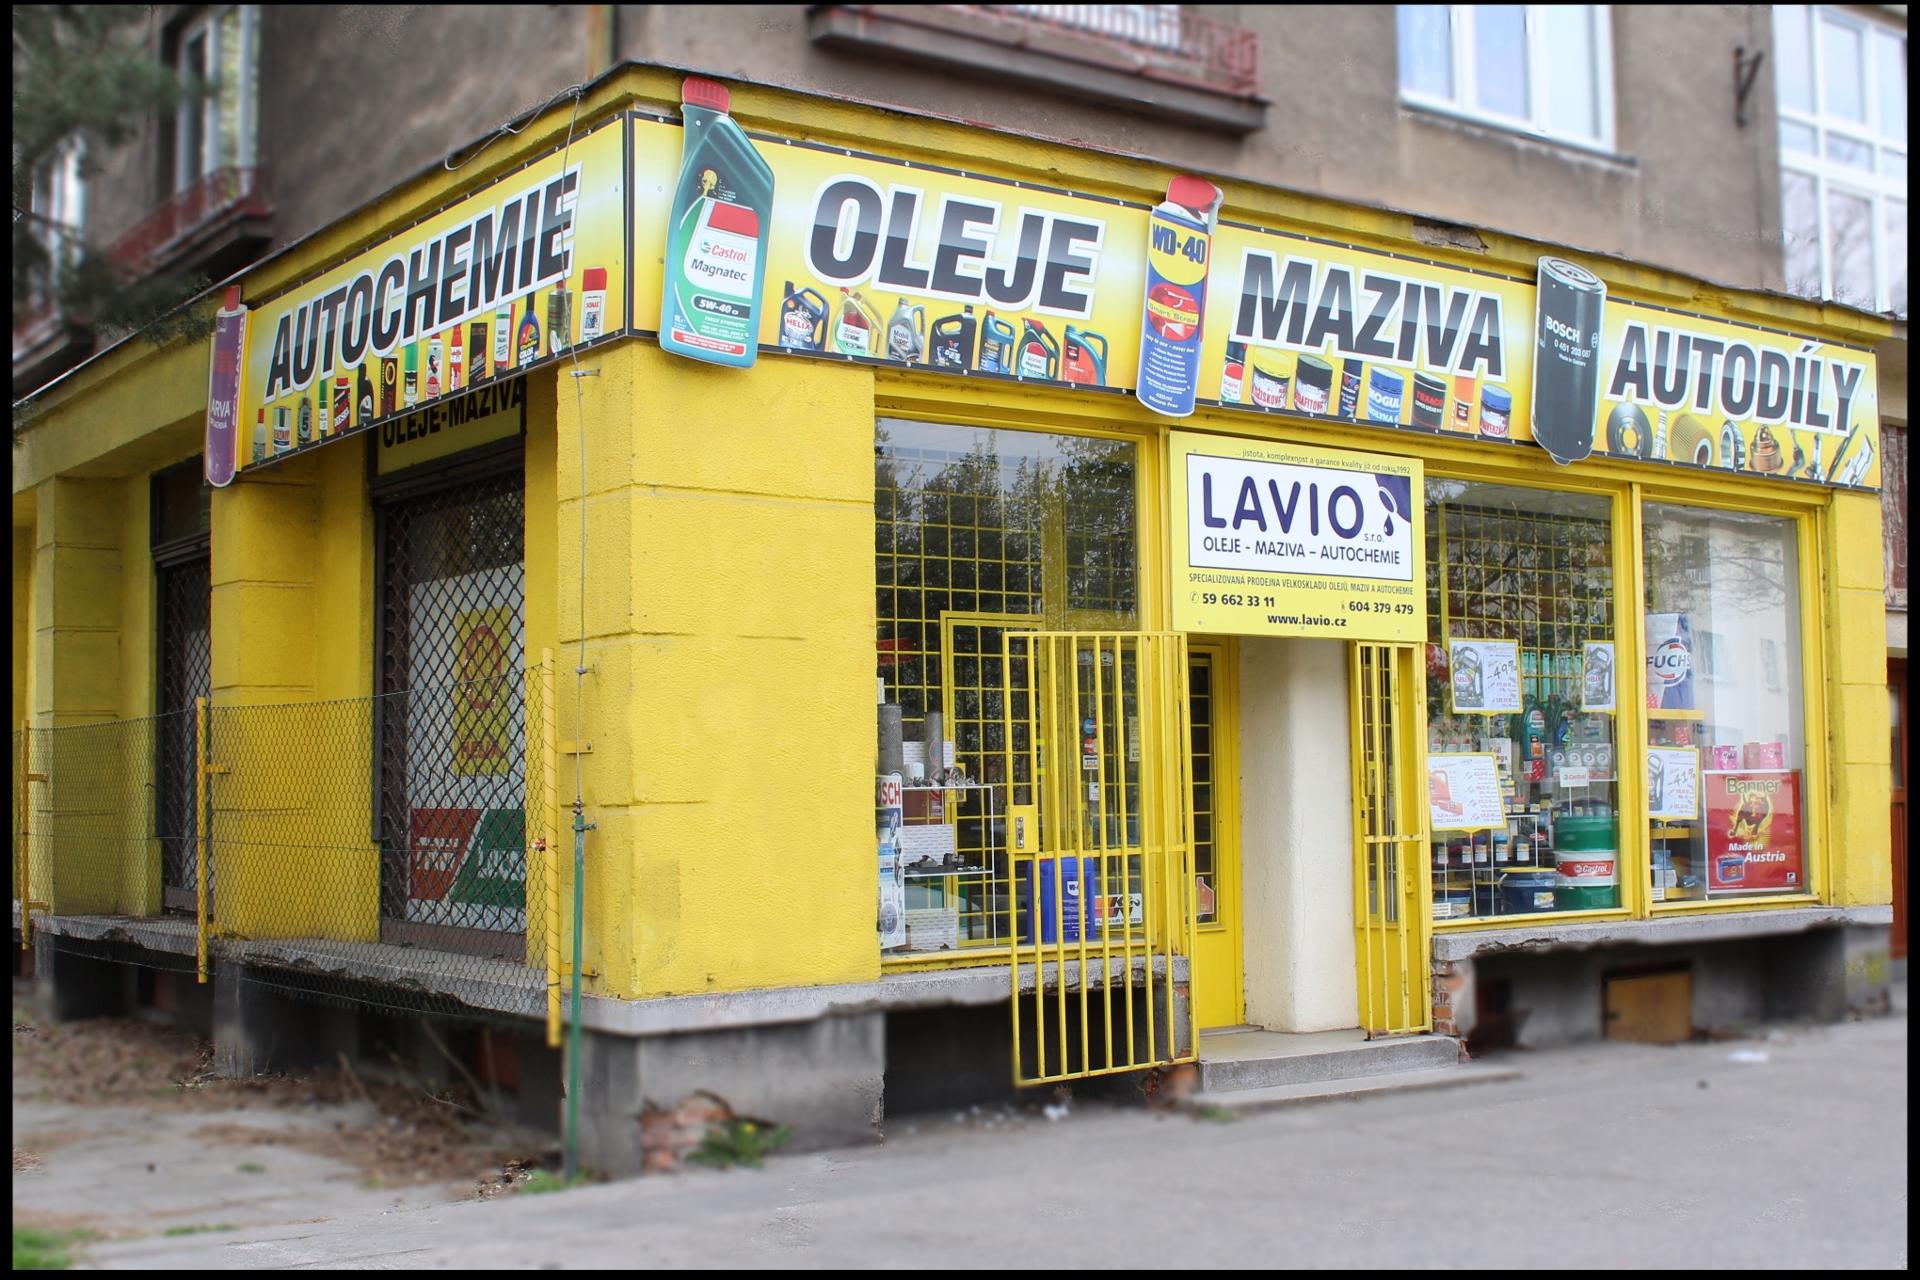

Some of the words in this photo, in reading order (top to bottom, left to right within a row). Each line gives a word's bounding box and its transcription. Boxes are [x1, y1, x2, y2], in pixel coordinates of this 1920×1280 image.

[810, 178, 1100, 315] OLEJE
[1152, 223, 1206, 264] WD-40
[711, 244, 748, 263] Castrol
[690, 258, 748, 281] Magnatec
[265, 167, 581, 400] AUTOCHEMIE
[698, 298, 732, 313] 5W-40
[1235, 252, 1503, 377] MAZIVA
[785, 317, 811, 330] HELIX
[1546, 315, 1581, 343] BOSCH
[1608, 324, 1861, 431] AUTODÍLY
[1315, 458, 1341, 467] garance
[1382, 464, 1394, 472] roku
[1397, 466, 1411, 474] 1992
[1203, 472, 1364, 539] LAVIO
[1364, 533, 1385, 543] s.r.o.
[1203, 536, 1241, 553] OLEJE
[1255, 540, 1305, 558] MAZIVA
[1320, 545, 1401, 565] AUTOCHEMIE
[1248, 577, 1280, 587] PRODEJNA
[1282, 579, 1327, 590] VELKOSKLADU
[1350, 583, 1369, 592] MAZIV
[1377, 585, 1413, 595] AUTOCHEMIE
[1202, 593, 1217, 604] 59
[1221, 594, 1243, 606] 662
[1247, 595, 1260, 607] 33
[1263, 596, 1275, 607] 11
[1349, 601, 1370, 612] 604
[1373, 602, 1391, 613] 379
[1394, 604, 1414, 615] 479
[1267, 613, 1347, 626] www.lavio.cz
[880, 781, 901, 805] SCH
[1726, 777, 1781, 794] Banner
[1728, 842, 1752, 851] Made
[1744, 851, 1786, 863] Austria
[1582, 864, 1609, 873] Castrol
